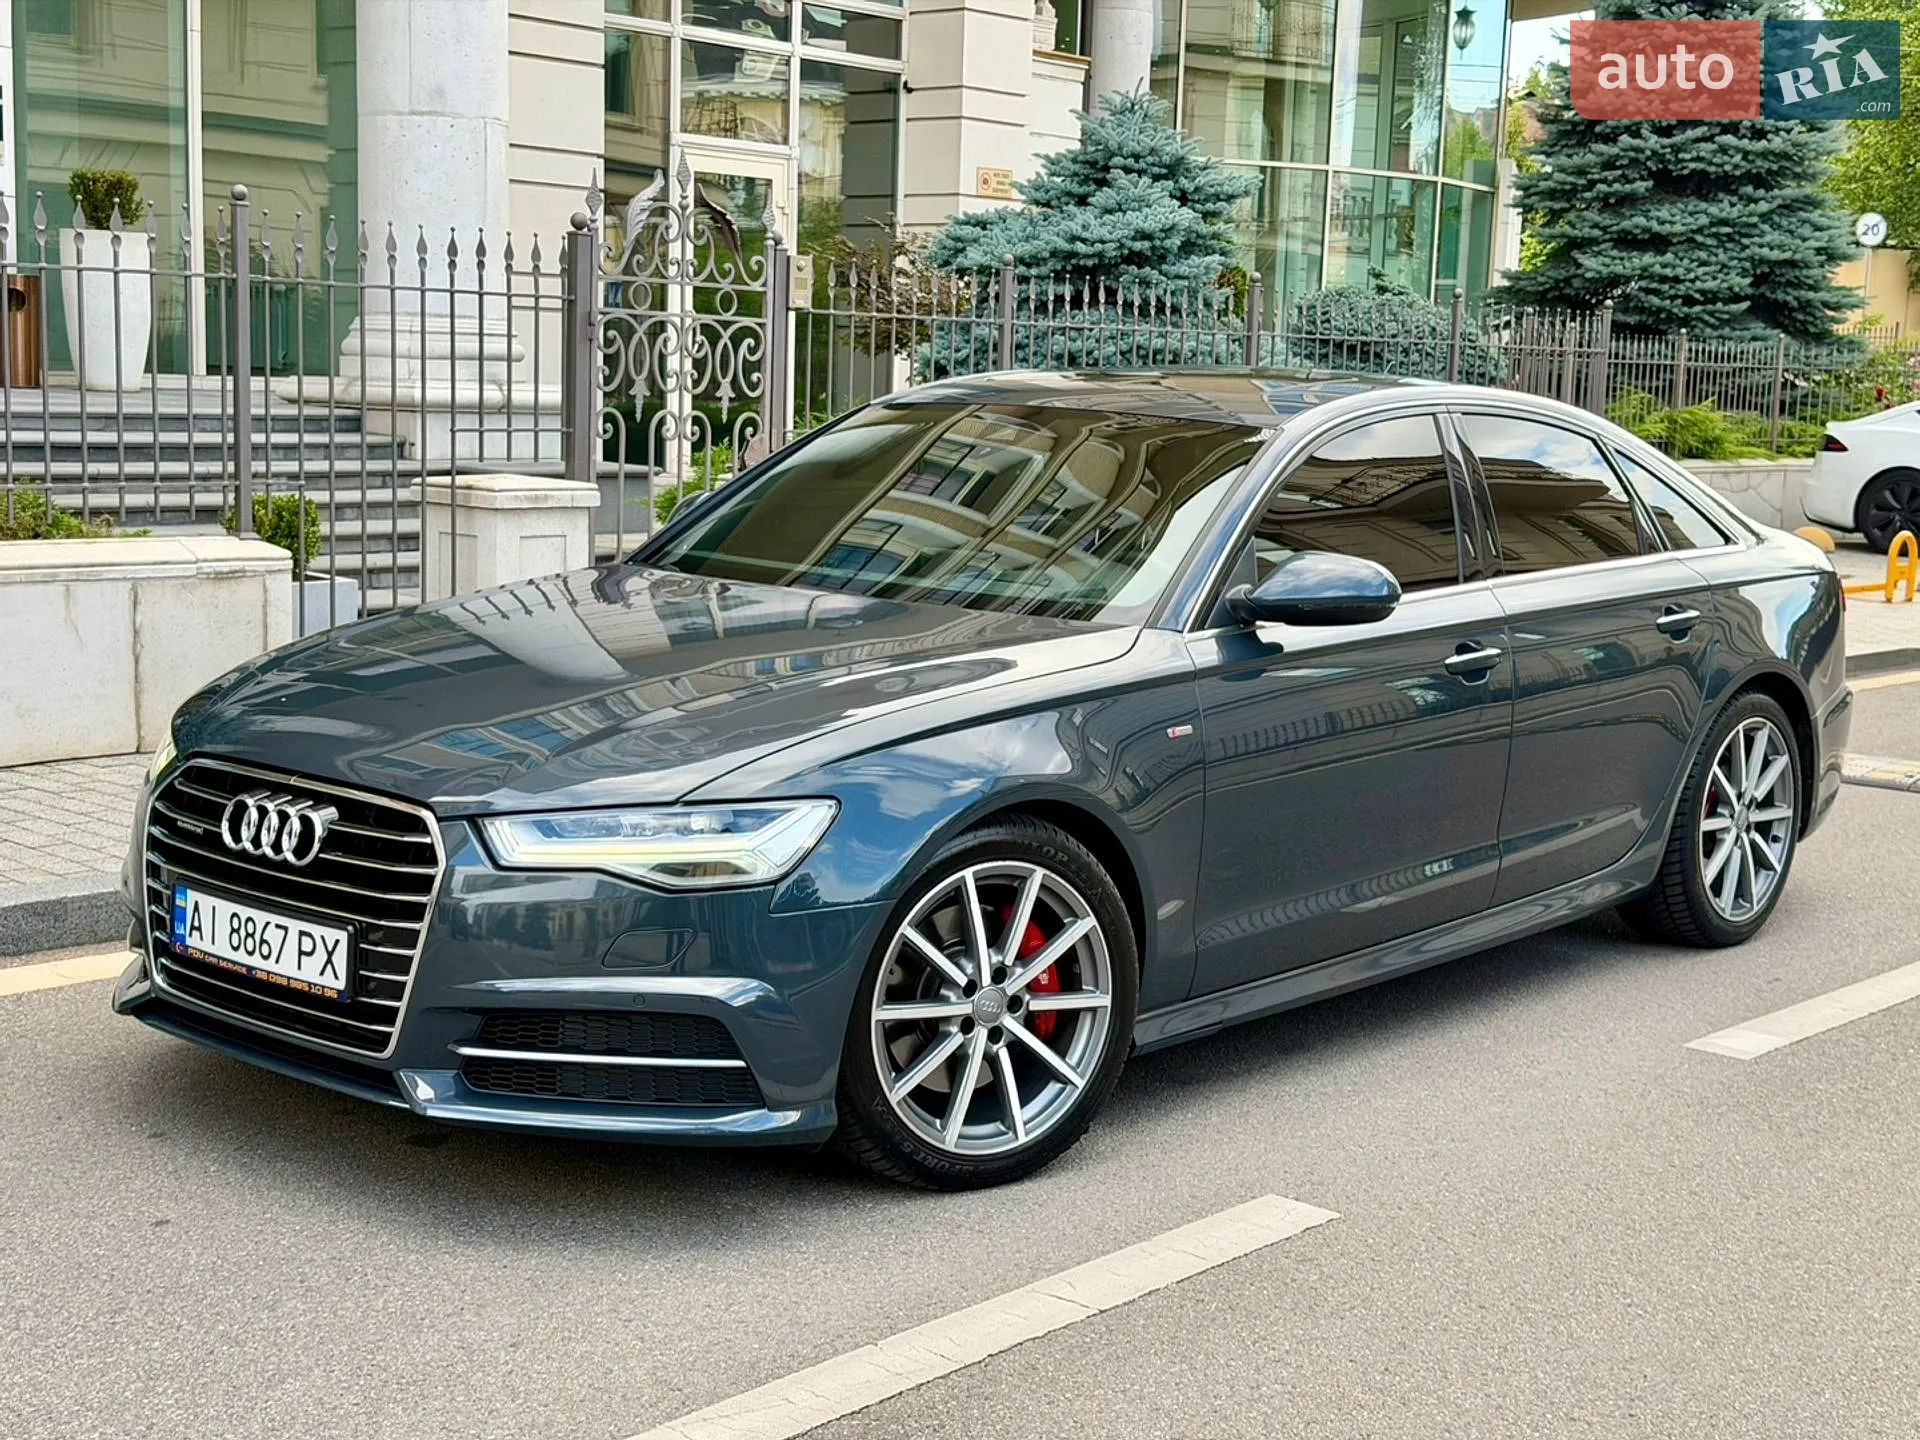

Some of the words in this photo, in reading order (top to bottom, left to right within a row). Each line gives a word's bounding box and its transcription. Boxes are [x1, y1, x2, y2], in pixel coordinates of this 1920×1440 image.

[1862, 223, 1880, 236] 20
[174, 921, 186, 935] UA
[188, 900, 216, 945] AI
[229, 911, 289, 964] 8867
[297, 929, 341, 981] PX
